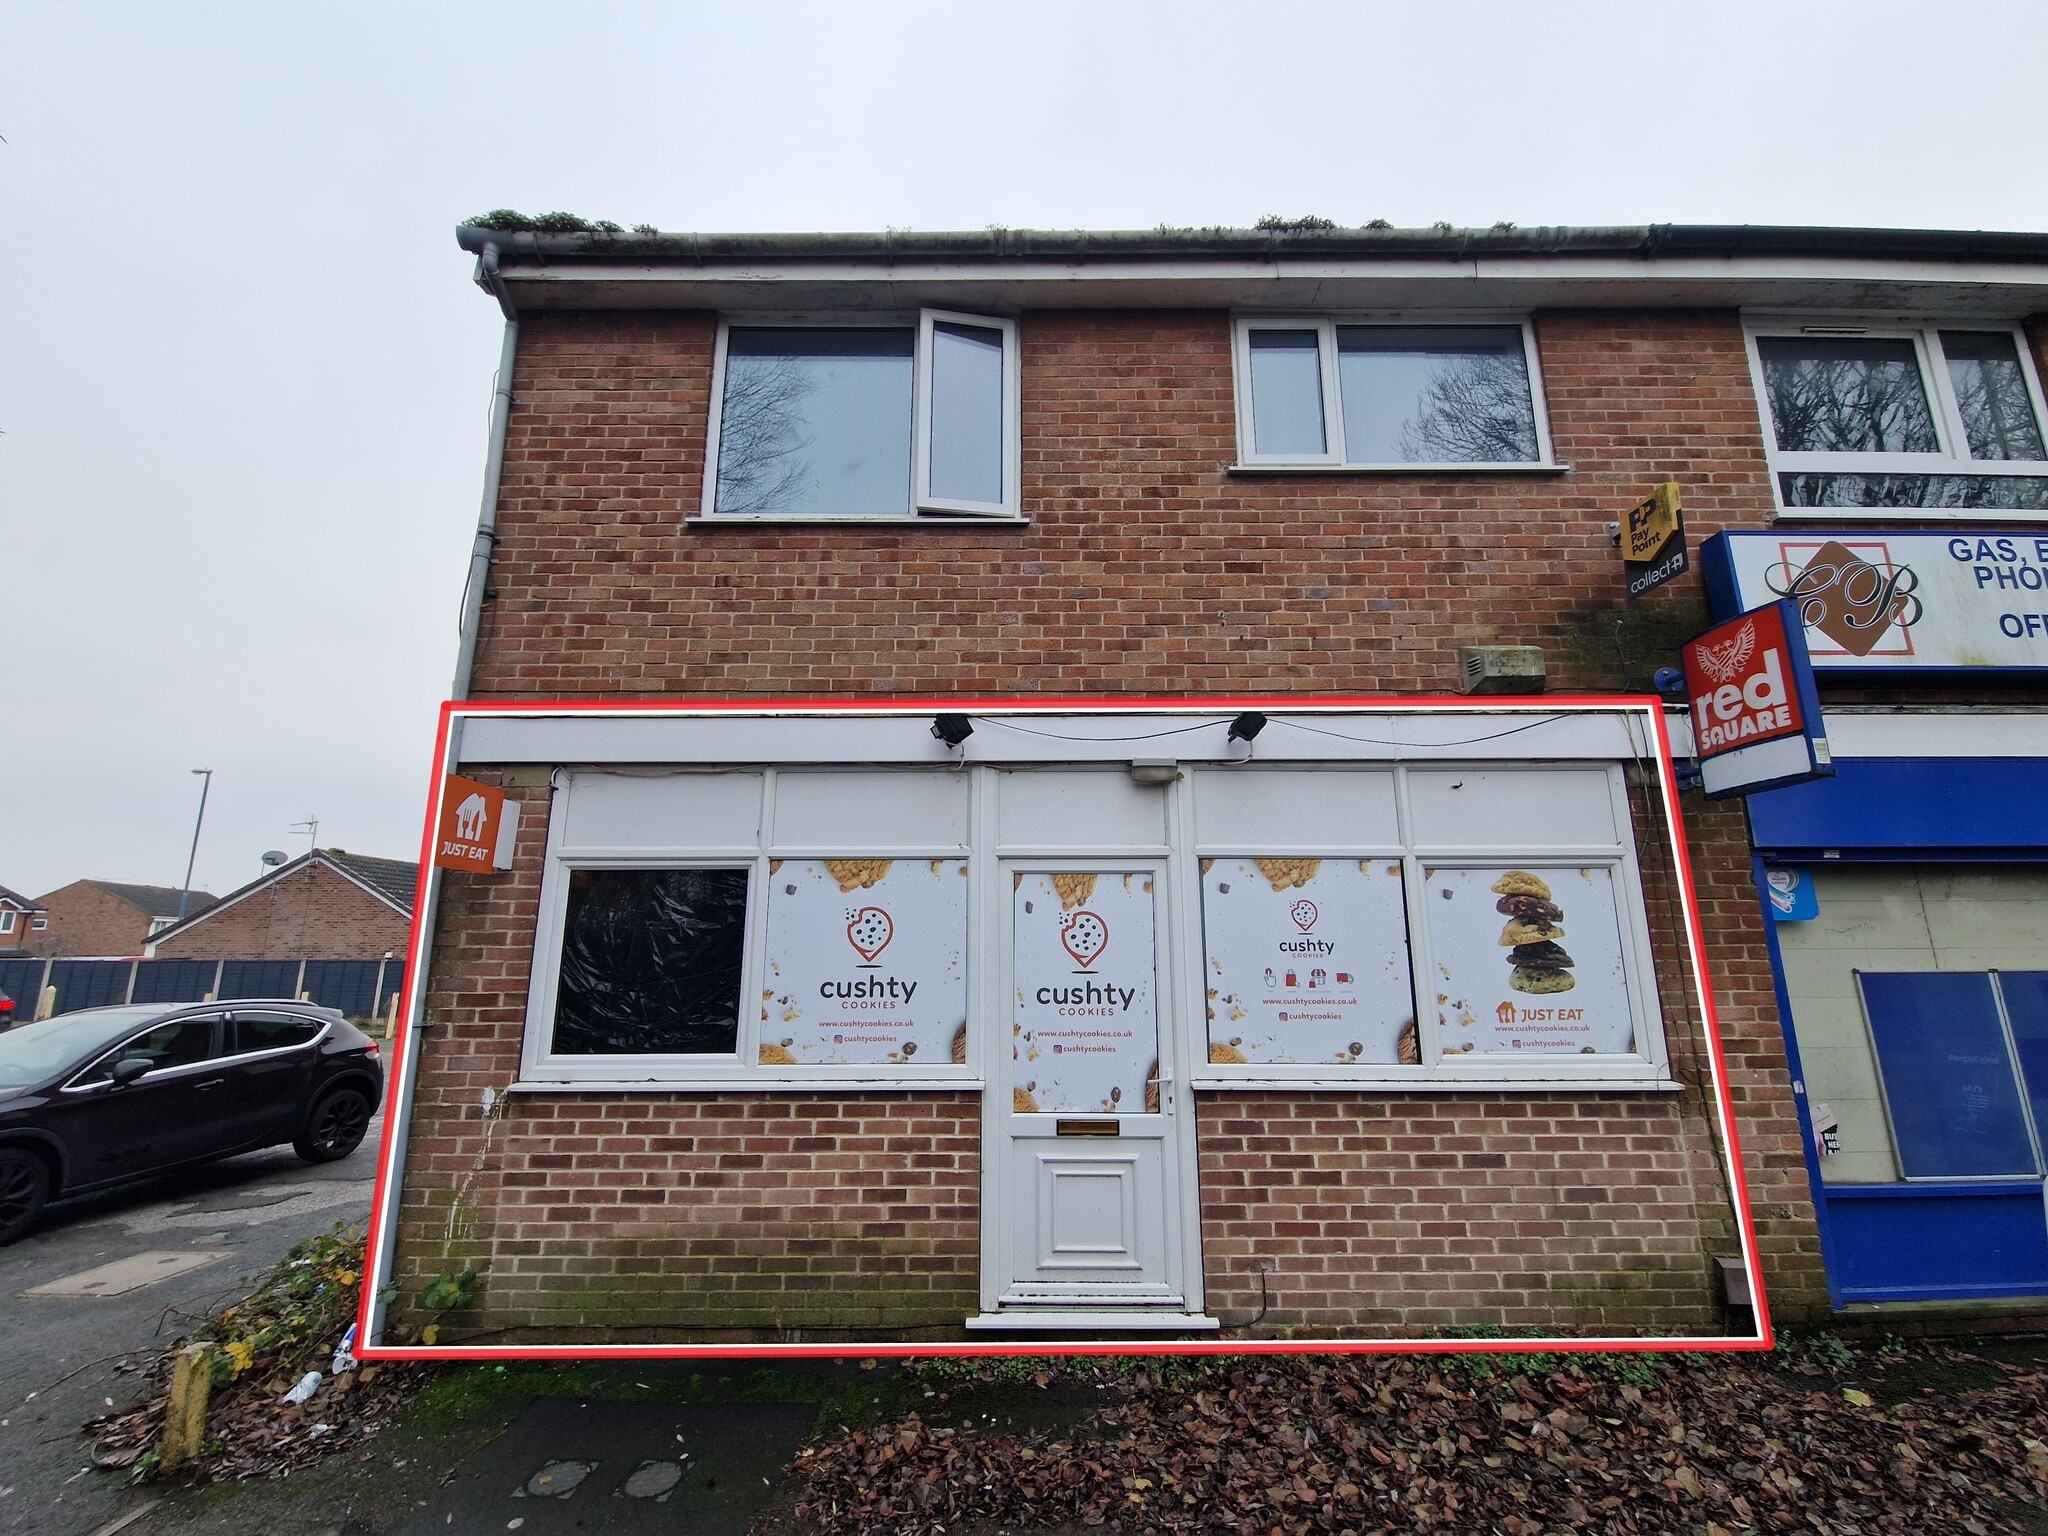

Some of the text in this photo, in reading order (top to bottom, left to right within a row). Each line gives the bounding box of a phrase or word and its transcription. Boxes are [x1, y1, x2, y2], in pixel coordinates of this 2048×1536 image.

[1631, 527, 1650, 545] Pay
[1632, 531, 1661, 556] Point
[1948, 538, 2027, 566] GAS,
[1973, 566, 2048, 591] PHO
[1999, 613, 2048, 639] OF
[1696, 647, 1787, 730] red
[1701, 705, 1792, 750] SQUARE
[441, 841, 489, 861] JUST EAT
[1279, 938, 1335, 955] cushty
[820, 974, 918, 1004] cushty
[1036, 980, 1136, 1011] cushty
[841, 1001, 896, 1009] COOKIES
[1262, 997, 1358, 1006] www.cushtycookies.co.uk
[1058, 1007, 1114, 1016] COOKIES
[1289, 1012, 1342, 1021] cushtycookies
[1521, 1009, 1584, 1022] JUST EAT
[818, 1020, 914, 1029] www.cushtycookies.co.uk
[1494, 1024, 1590, 1033] www.cushtycookies.co.uk
[843, 1035, 897, 1044] cushtycookies
[1037, 1030, 1133, 1039] www.cushtycookies.co.uk
[1063, 1045, 1117, 1054] cushtycookies
[1522, 1039, 1575, 1048] cushtycookies
